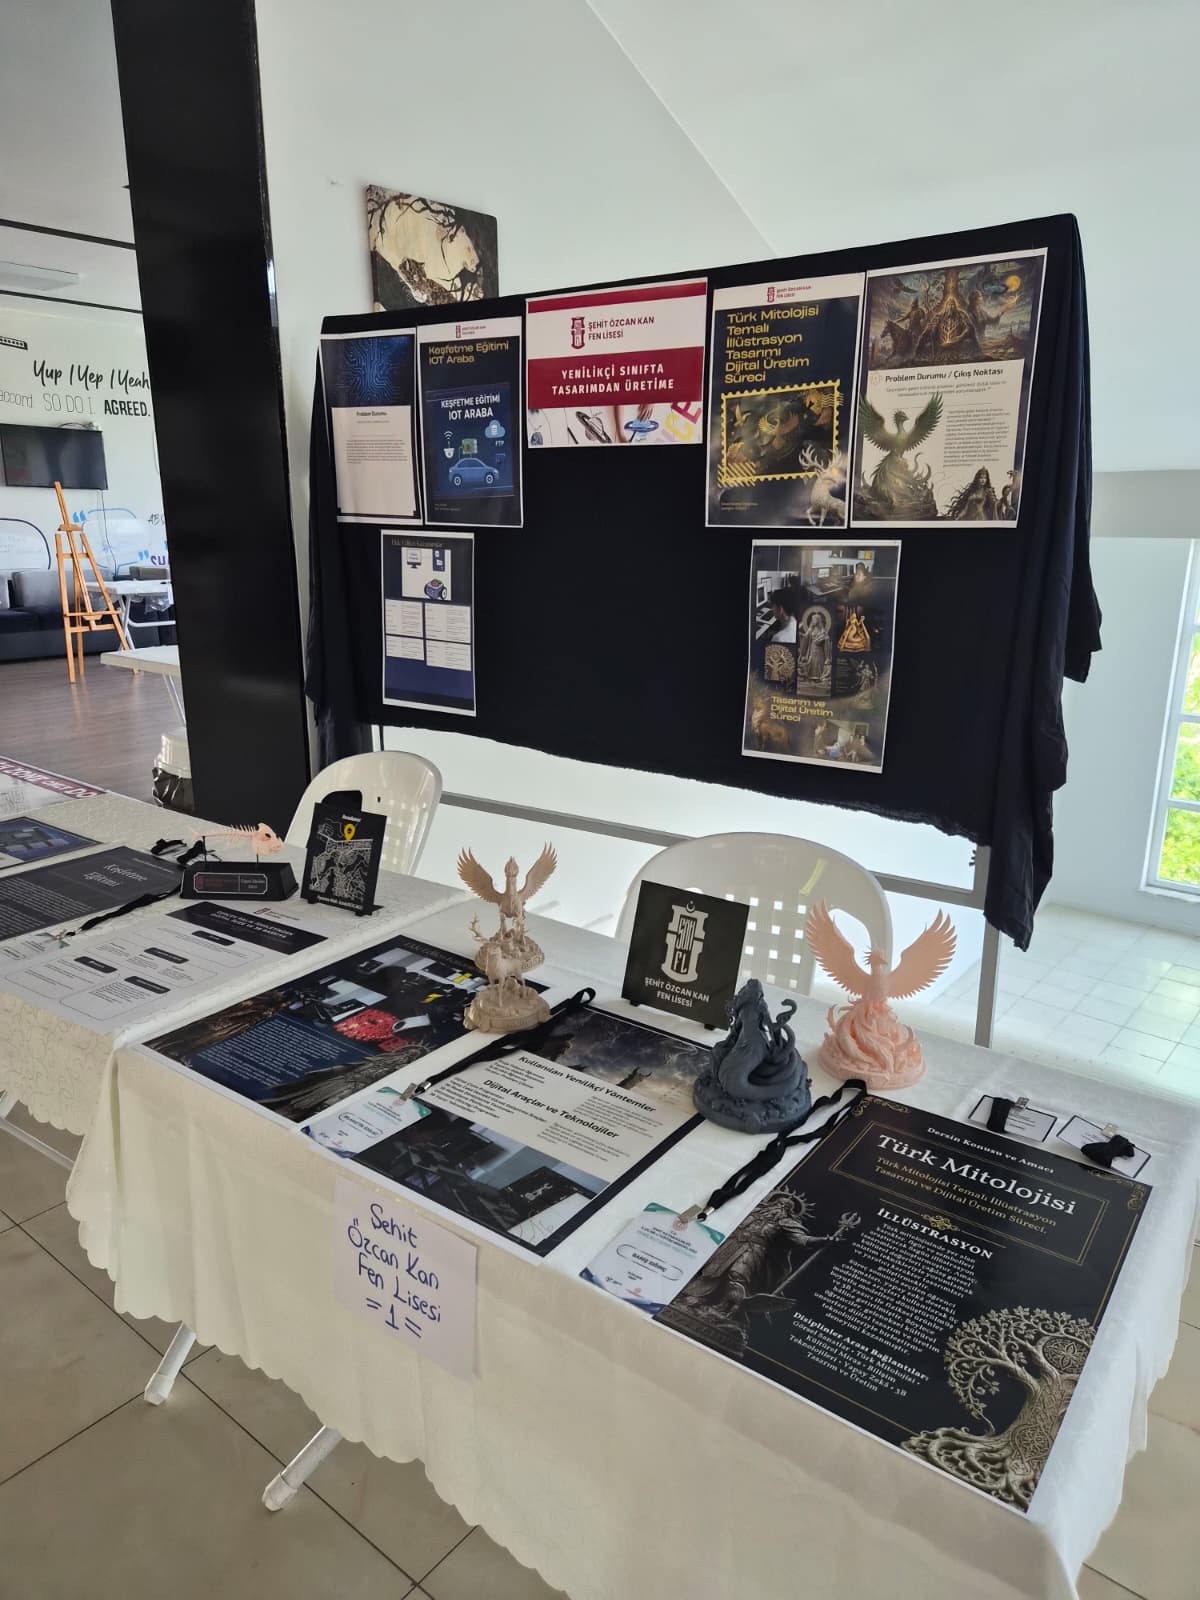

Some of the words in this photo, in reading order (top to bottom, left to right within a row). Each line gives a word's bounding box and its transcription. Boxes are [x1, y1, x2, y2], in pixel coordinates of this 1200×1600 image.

[728, 312, 757, 324] Türk
[761, 305, 819, 320] Mitolojisi
[588, 320, 608, 331] ŞEHİT
[609, 318, 637, 327] ÖZCAN
[637, 316, 655, 325] KAN
[727, 323, 769, 336] Temalı
[588, 332, 602, 340] FEN
[602, 329, 623, 339] LİSESİ
[726, 348, 781, 360] Tasarımı
[562, 364, 615, 379] YENİLİKÇİ
[619, 363, 664, 375] SINIFTA
[725, 360, 759, 373] Dijital
[764, 357, 809, 369] Üretim
[724, 372, 766, 384] Süreci
[954, 370, 971, 378] Çıkış
[552, 382, 620, 395] TASARIMDAN
[625, 378, 674, 392] ÜRETİME
[441, 397, 474, 408] KEŞFETME
[475, 393, 500, 405] EĞİTİMİ
[449, 410, 462, 421] IOT
[464, 407, 493, 419] ARABA
[645, 976, 664, 989] ŞEHİT
[665, 981, 692, 996] ÖZCAN
[692, 992, 709, 1003] KAN
[657, 991, 672, 1001] FEN
[671, 995, 693, 1008] LİSESİ
[518, 1056, 563, 1076] Kullanılan
[565, 1073, 604, 1091] Yenilikçi
[605, 1088, 655, 1111] Yöntemler
[483, 1079, 512, 1094] Dijital
[510, 1091, 545, 1107] Araçlar
[545, 1105, 558, 1113] ve
[559, 1110, 618, 1137] Teknolojiler
[927, 1127, 960, 1142] Dersin
[962, 1139, 1002, 1155] Konusu
[1018, 1158, 1053, 1173] Amacı
[878, 1134, 936, 1165] Türk
[940, 1158, 1075, 1214] Mitolojisi
[875, 1165, 917, 1185] Tasarımı
[933, 1187, 966, 1203] Dijital
[968, 1199, 1006, 1218] Üretim
[1008, 1215, 1046, 1233] Süreci.
[877, 1157, 898, 1168] Türk
[900, 1165, 950, 1187] Mitolojisi
[952, 1183, 987, 1200] Temalı
[990, 1197, 1056, 1226] İllüstrasyon
[877, 1208, 992, 1258] İLLÜSTRASYON
[348, 1218, 399, 1269] Özcan
[406, 1251, 439, 1289] Kan
[358, 1251, 384, 1290] Fen
[394, 1275, 440, 1323] Lisesi
[843, 1336, 868, 1351] Arası
[856, 1350, 874, 1363] Türk
